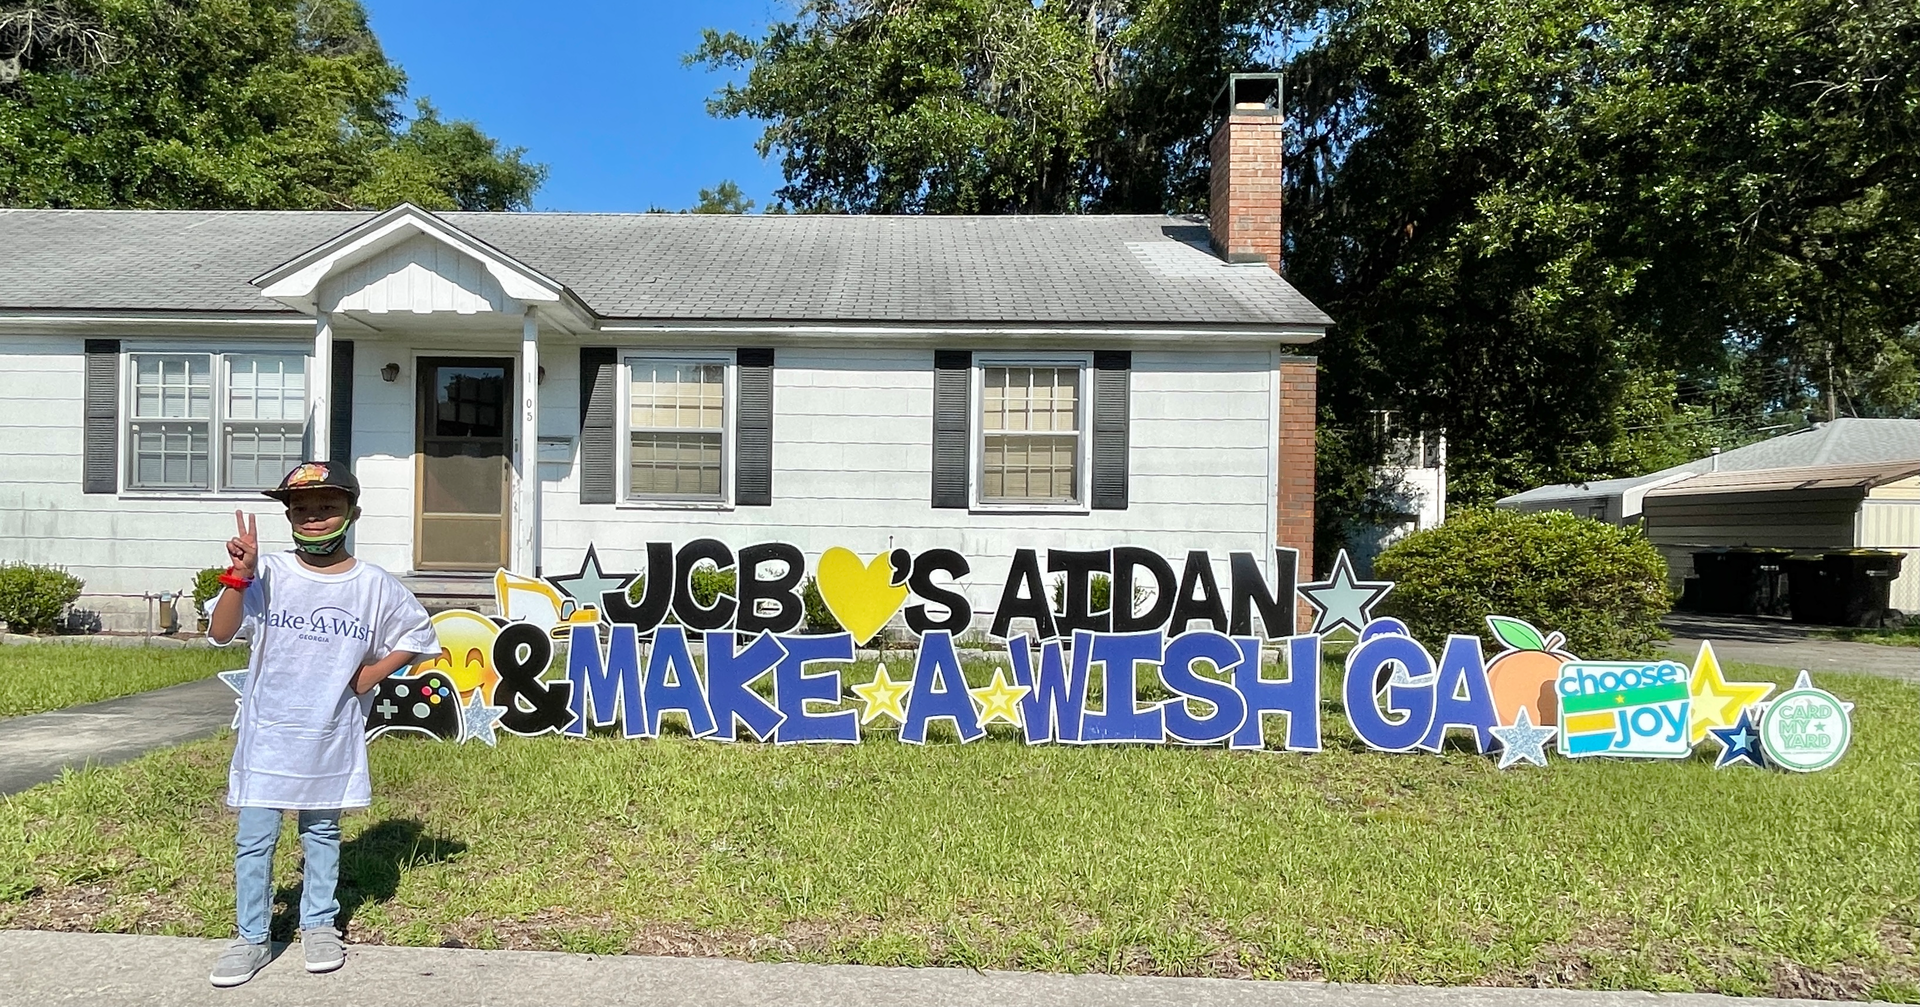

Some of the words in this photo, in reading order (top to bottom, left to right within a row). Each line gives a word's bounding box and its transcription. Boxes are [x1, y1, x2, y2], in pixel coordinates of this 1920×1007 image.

[602, 538, 805, 633] JCB
[990, 546, 1298, 639] AIDAN
[266, 608, 374, 641] ake-A-Wish
[299, 634, 329, 642] GEORGIA
[493, 622, 577, 734] &
[565, 623, 860, 744] MAKE
[899, 629, 986, 744] A
[1006, 628, 1322, 752] WISH
[1343, 634, 1501, 754] GA
[1558, 664, 1678, 697] choose
[1613, 702, 1690, 749] joy
[1778, 704, 1833, 719] CARD
[1778, 719, 1811, 734] MY
[1780, 733, 1832, 750] YARD
